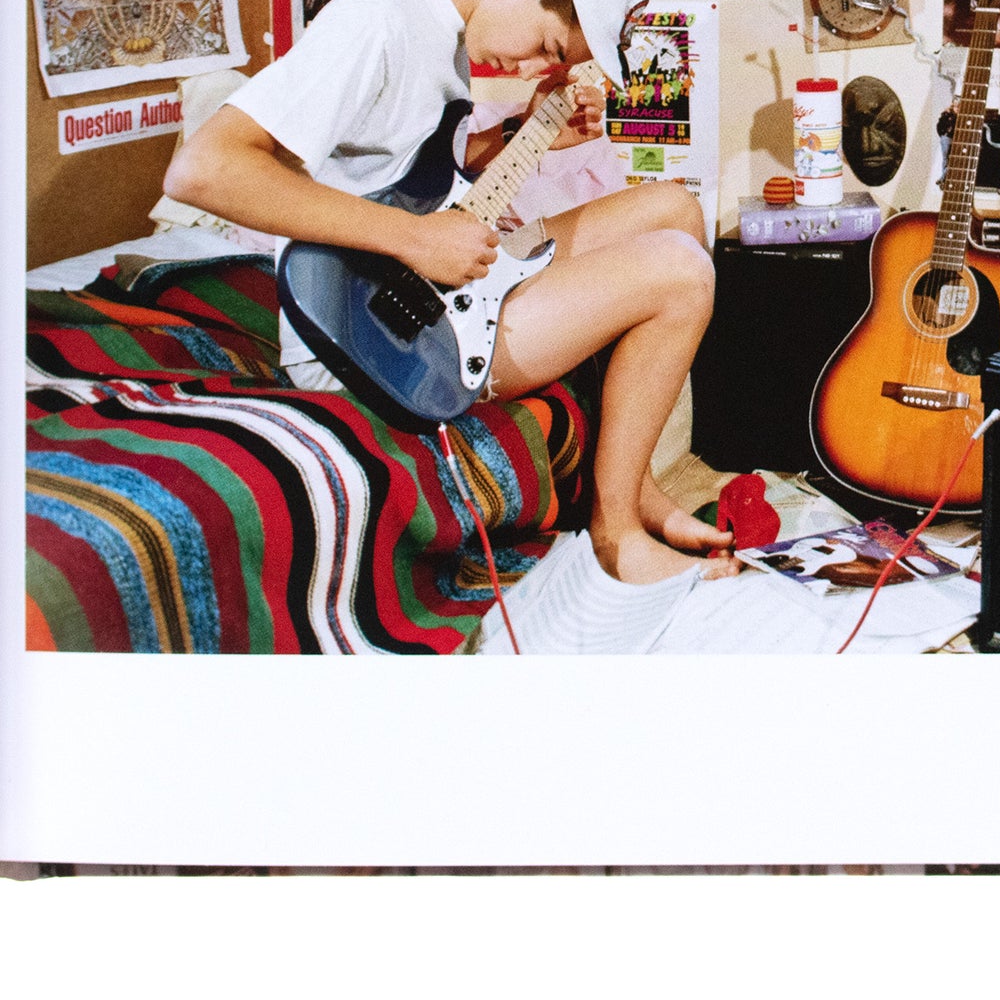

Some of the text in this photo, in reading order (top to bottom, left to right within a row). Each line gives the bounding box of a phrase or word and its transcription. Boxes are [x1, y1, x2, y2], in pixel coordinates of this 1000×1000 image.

[618, 108, 674, 119] SYRACUSE
[64, 99, 184, 147] Question Autho
[623, 122, 666, 137] AUGUST
[668, 123, 676, 137] 5
